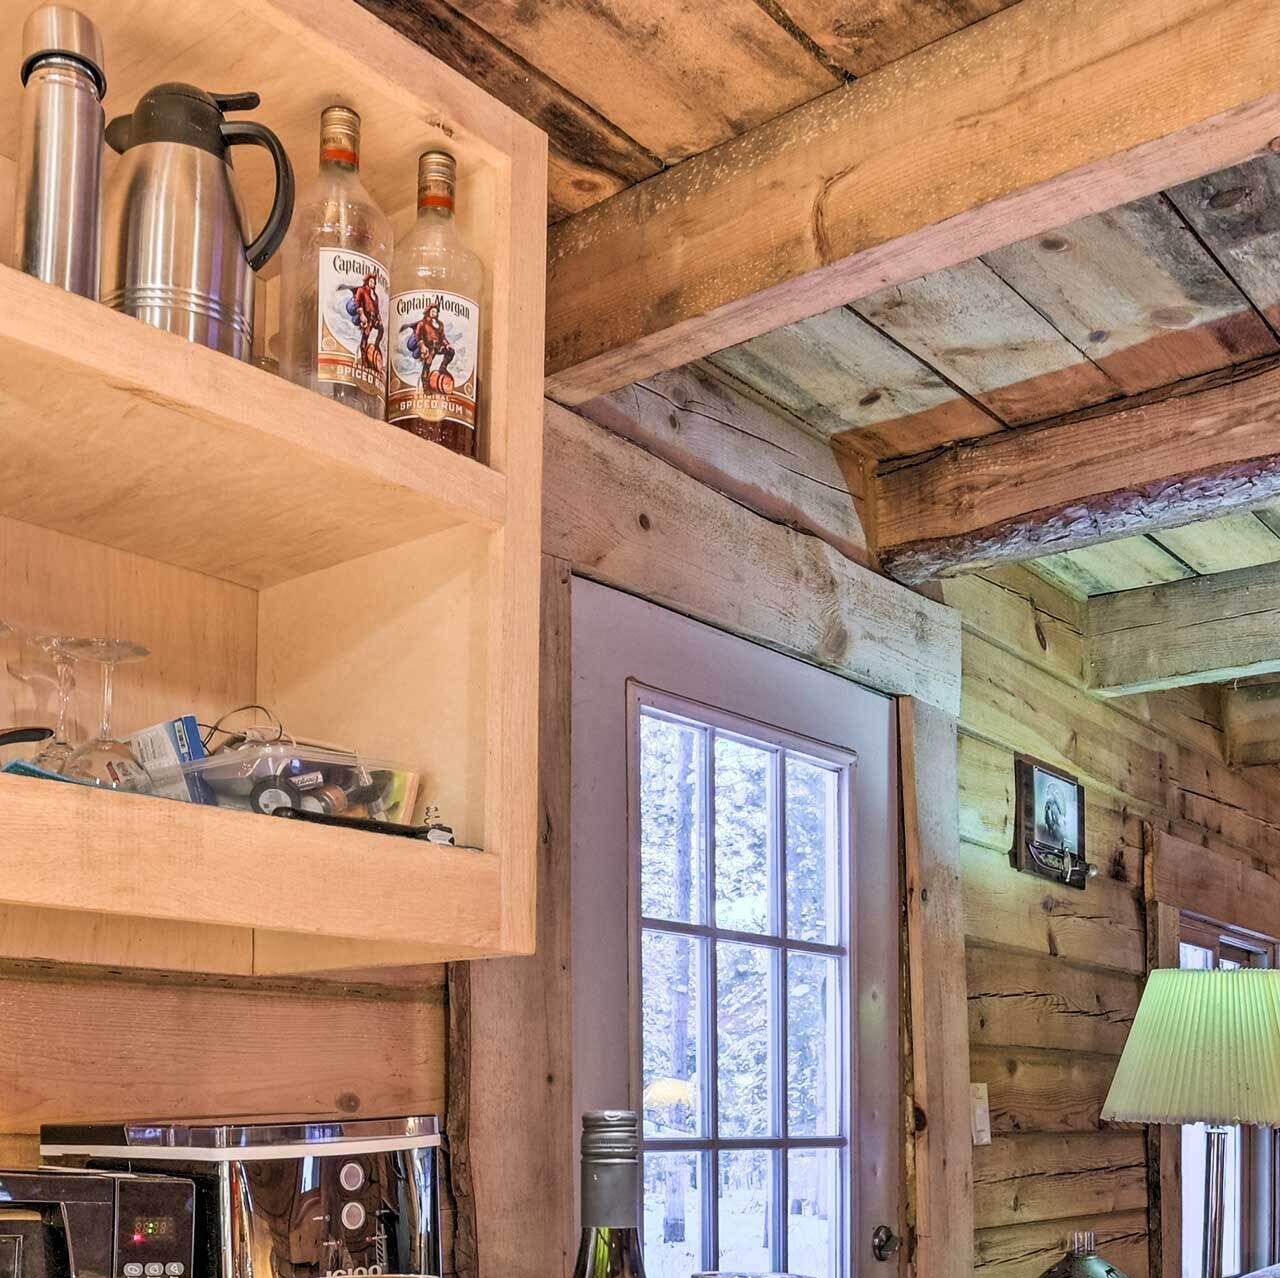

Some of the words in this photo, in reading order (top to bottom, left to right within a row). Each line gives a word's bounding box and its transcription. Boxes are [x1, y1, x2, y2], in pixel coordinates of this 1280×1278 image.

[333, 254, 371, 276] Captain
[397, 295, 432, 316] Captain
[435, 294, 470, 320] Morgan
[336, 364, 374, 385] SPICED
[400, 400, 439, 411] SPICED
[441, 401, 464, 415] RUM
